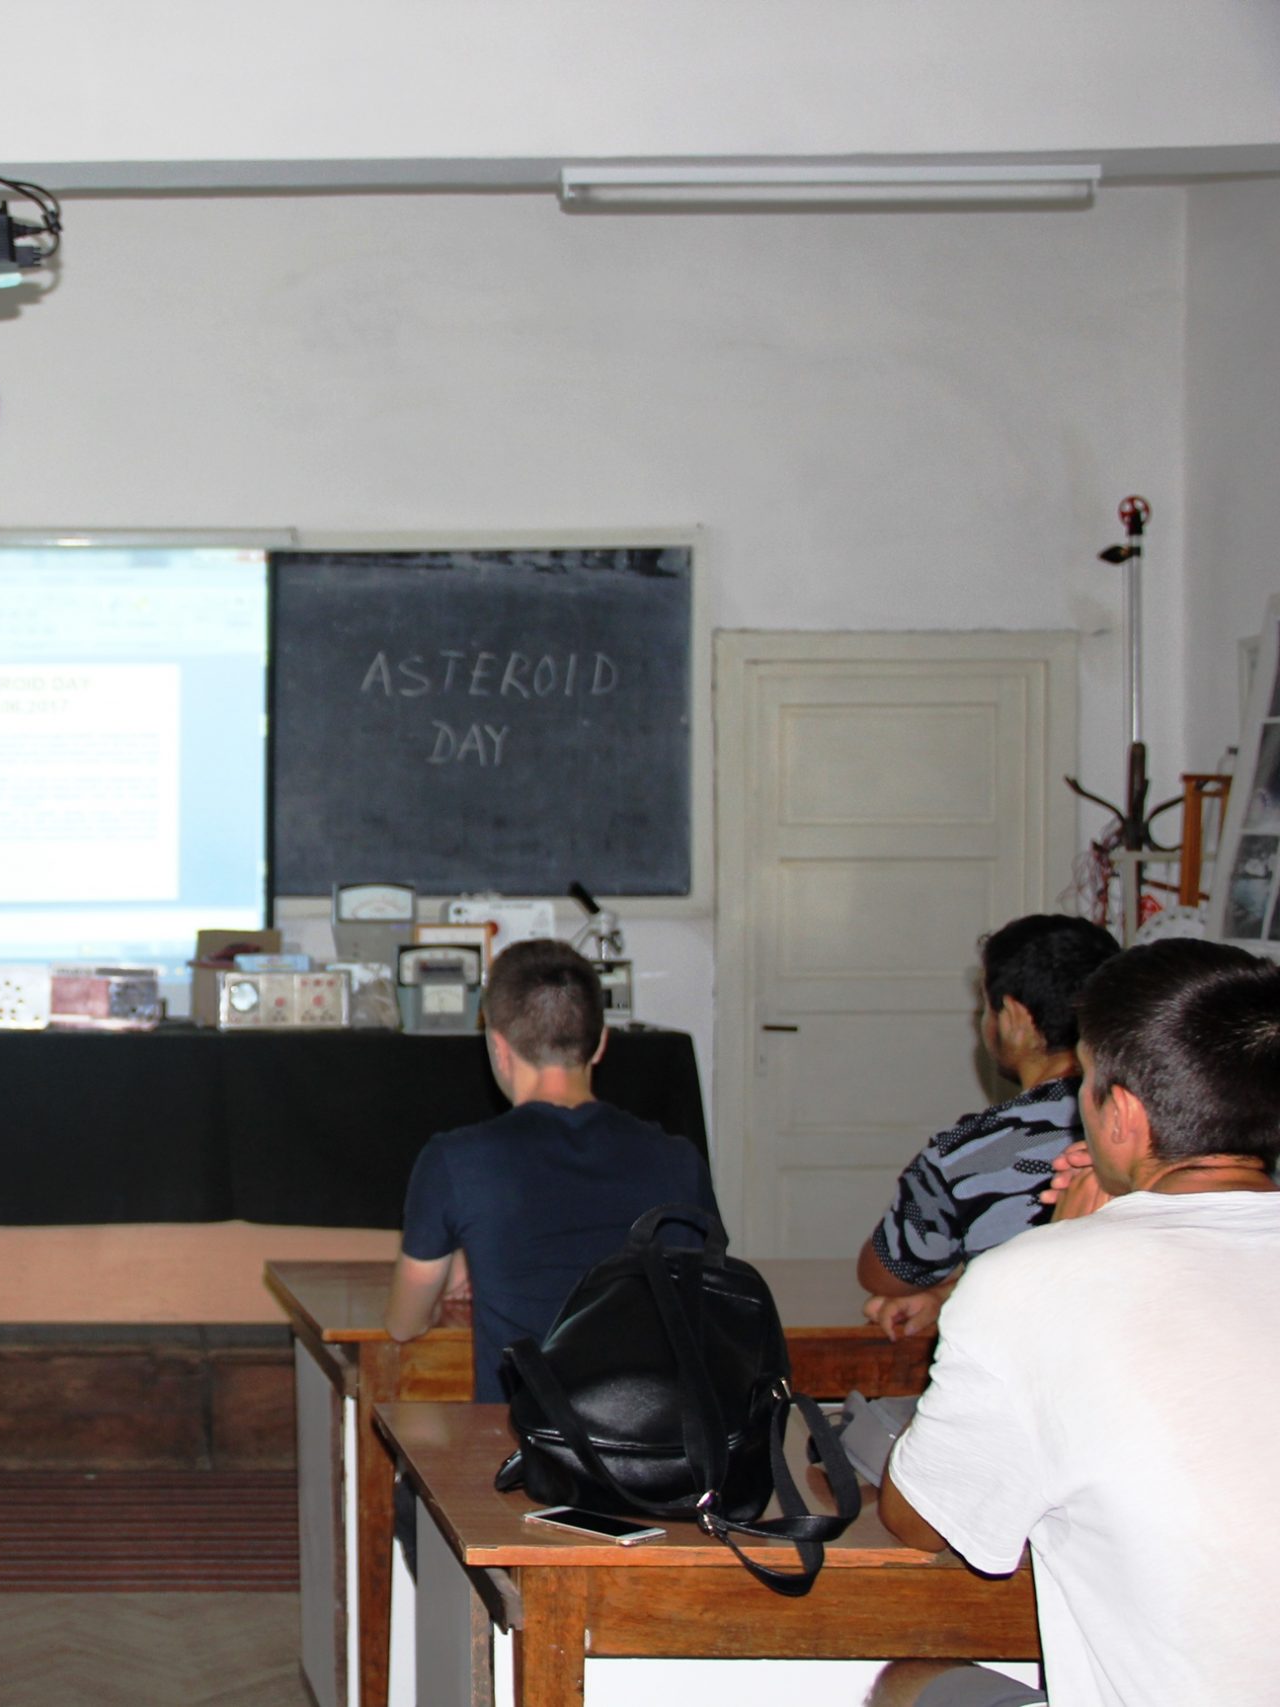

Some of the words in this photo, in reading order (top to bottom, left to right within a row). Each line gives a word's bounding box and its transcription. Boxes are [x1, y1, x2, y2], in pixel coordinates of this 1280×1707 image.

[51, 676, 91, 691] DAY
[360, 650, 620, 699] ASTEROID
[427, 719, 511, 767] DAY
